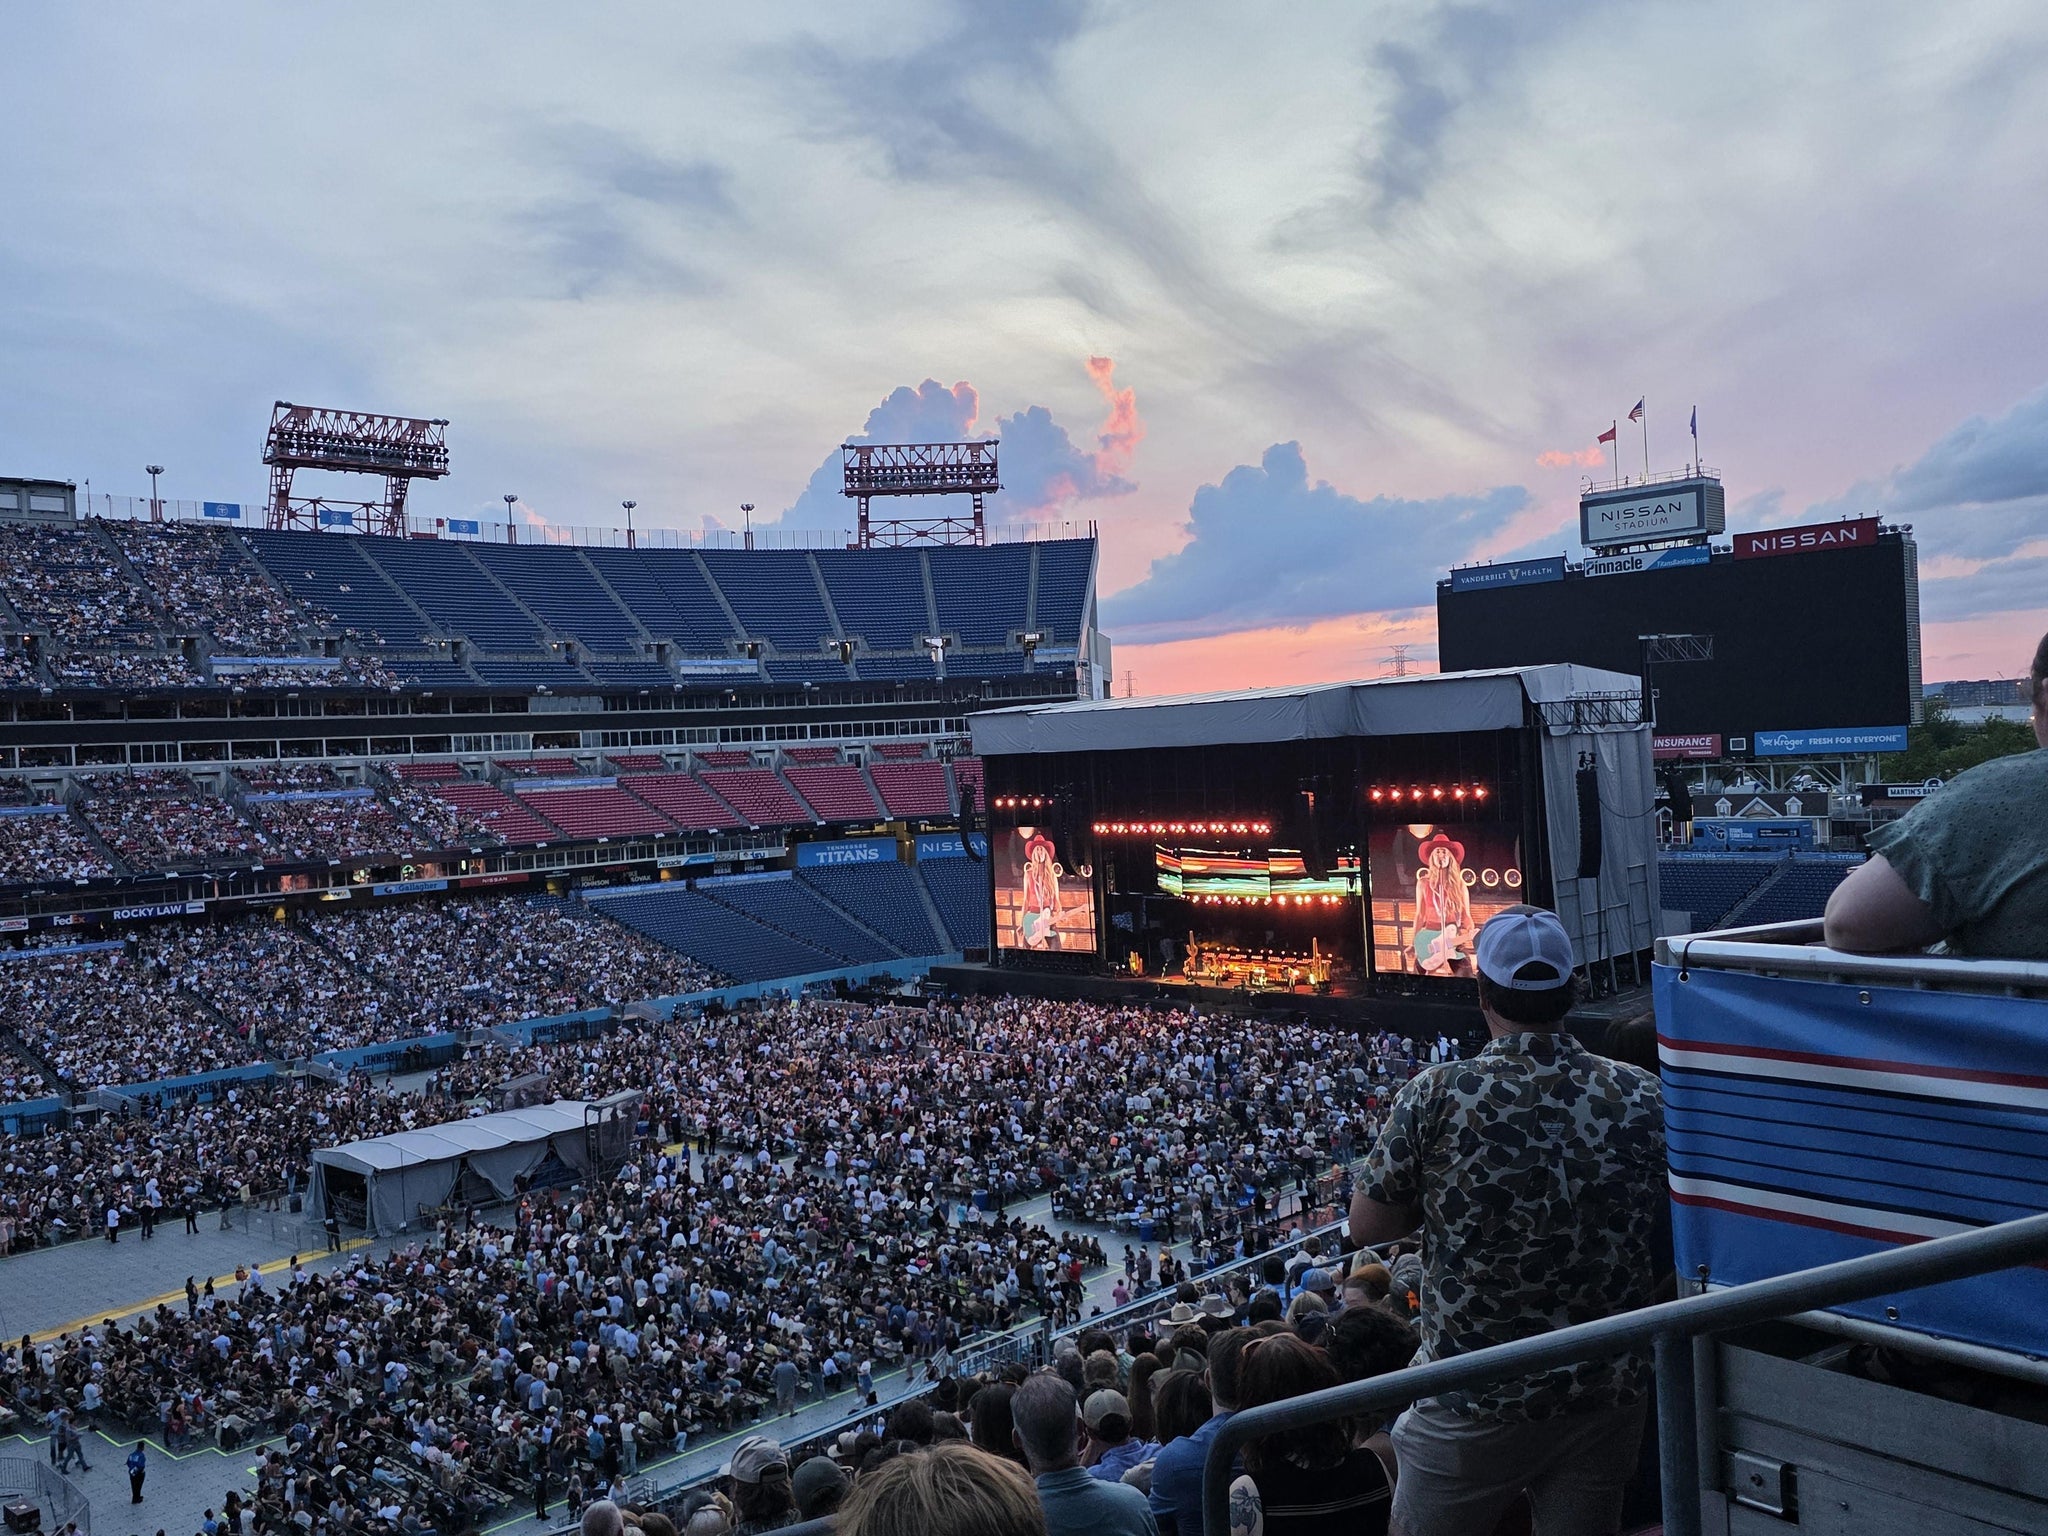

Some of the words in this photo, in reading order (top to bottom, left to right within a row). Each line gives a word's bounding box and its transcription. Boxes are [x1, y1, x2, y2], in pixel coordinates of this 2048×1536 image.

[1601, 501, 1682, 522] NISSAN
[1614, 517, 1669, 531] STADIUM
[1751, 527, 1857, 552] NISSAN
[1586, 556, 1643, 575] Pinnacle
[1460, 572, 1507, 584] VANDERBILT
[1521, 567, 1553, 577] HEALTH
[1653, 737, 1712, 747] INSURANCE
[1773, 734, 1804, 751] Kroger
[1808, 737, 1833, 745] FRESH
[1835, 736, 1852, 744] FOR
[1890, 788, 1921, 796] MARTIN'S
[816, 849, 880, 863] TITANS
[398, 883, 438, 892] Gallagher
[113, 909, 153, 920] ROCKY
[156, 905, 182, 915] LAW
[53, 914, 86, 926] FedEx
